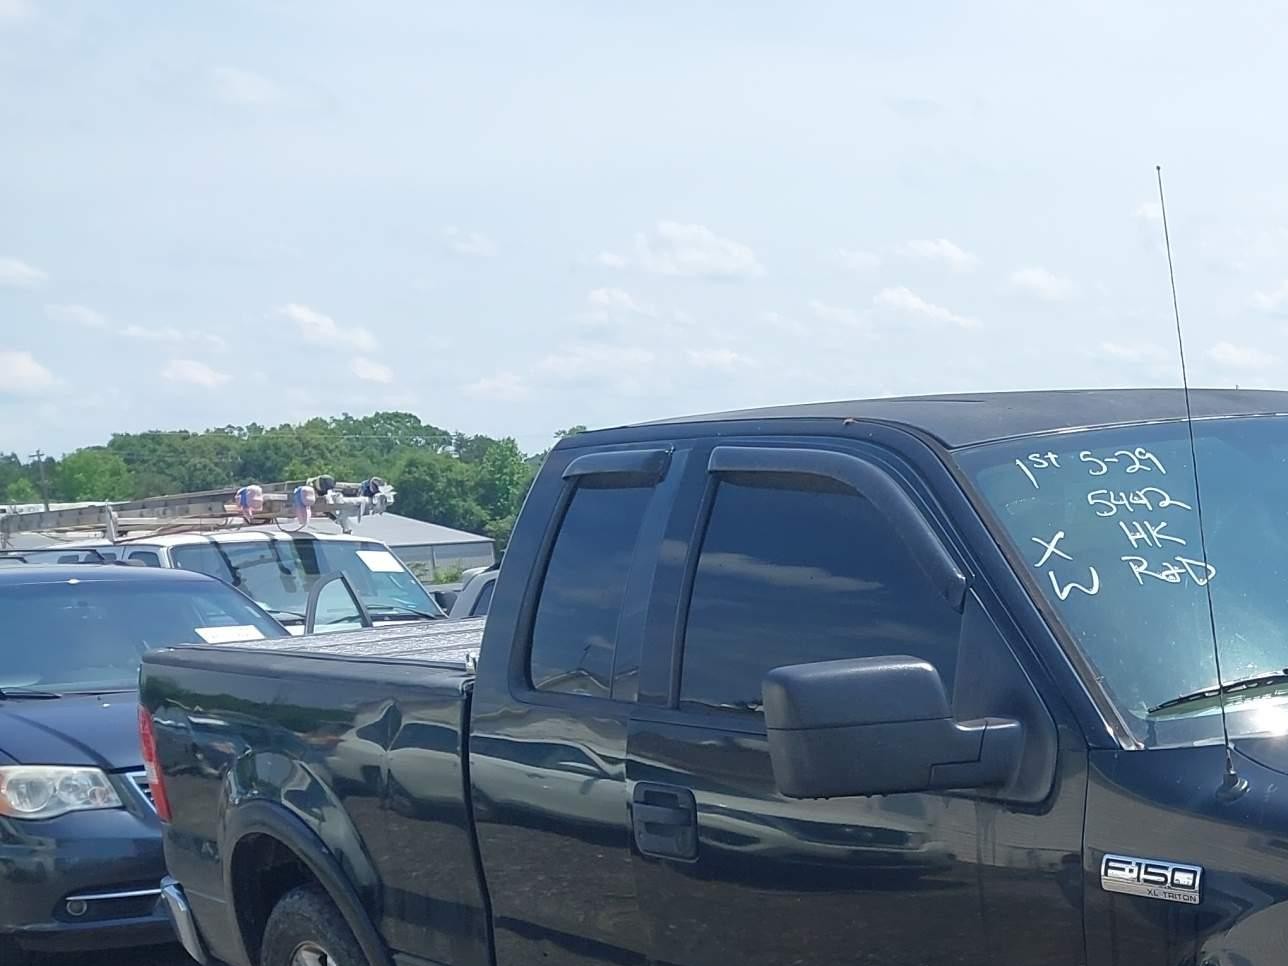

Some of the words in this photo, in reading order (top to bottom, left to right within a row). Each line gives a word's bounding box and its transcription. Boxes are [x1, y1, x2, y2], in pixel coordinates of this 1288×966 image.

[1015, 451, 1061, 489] 1st
[1087, 487, 1192, 517] 5442
[1031, 531, 1074, 568] X
[1119, 520, 1187, 549] HK
[1048, 566, 1100, 601] W
[1162, 890, 1197, 903] TRITON
